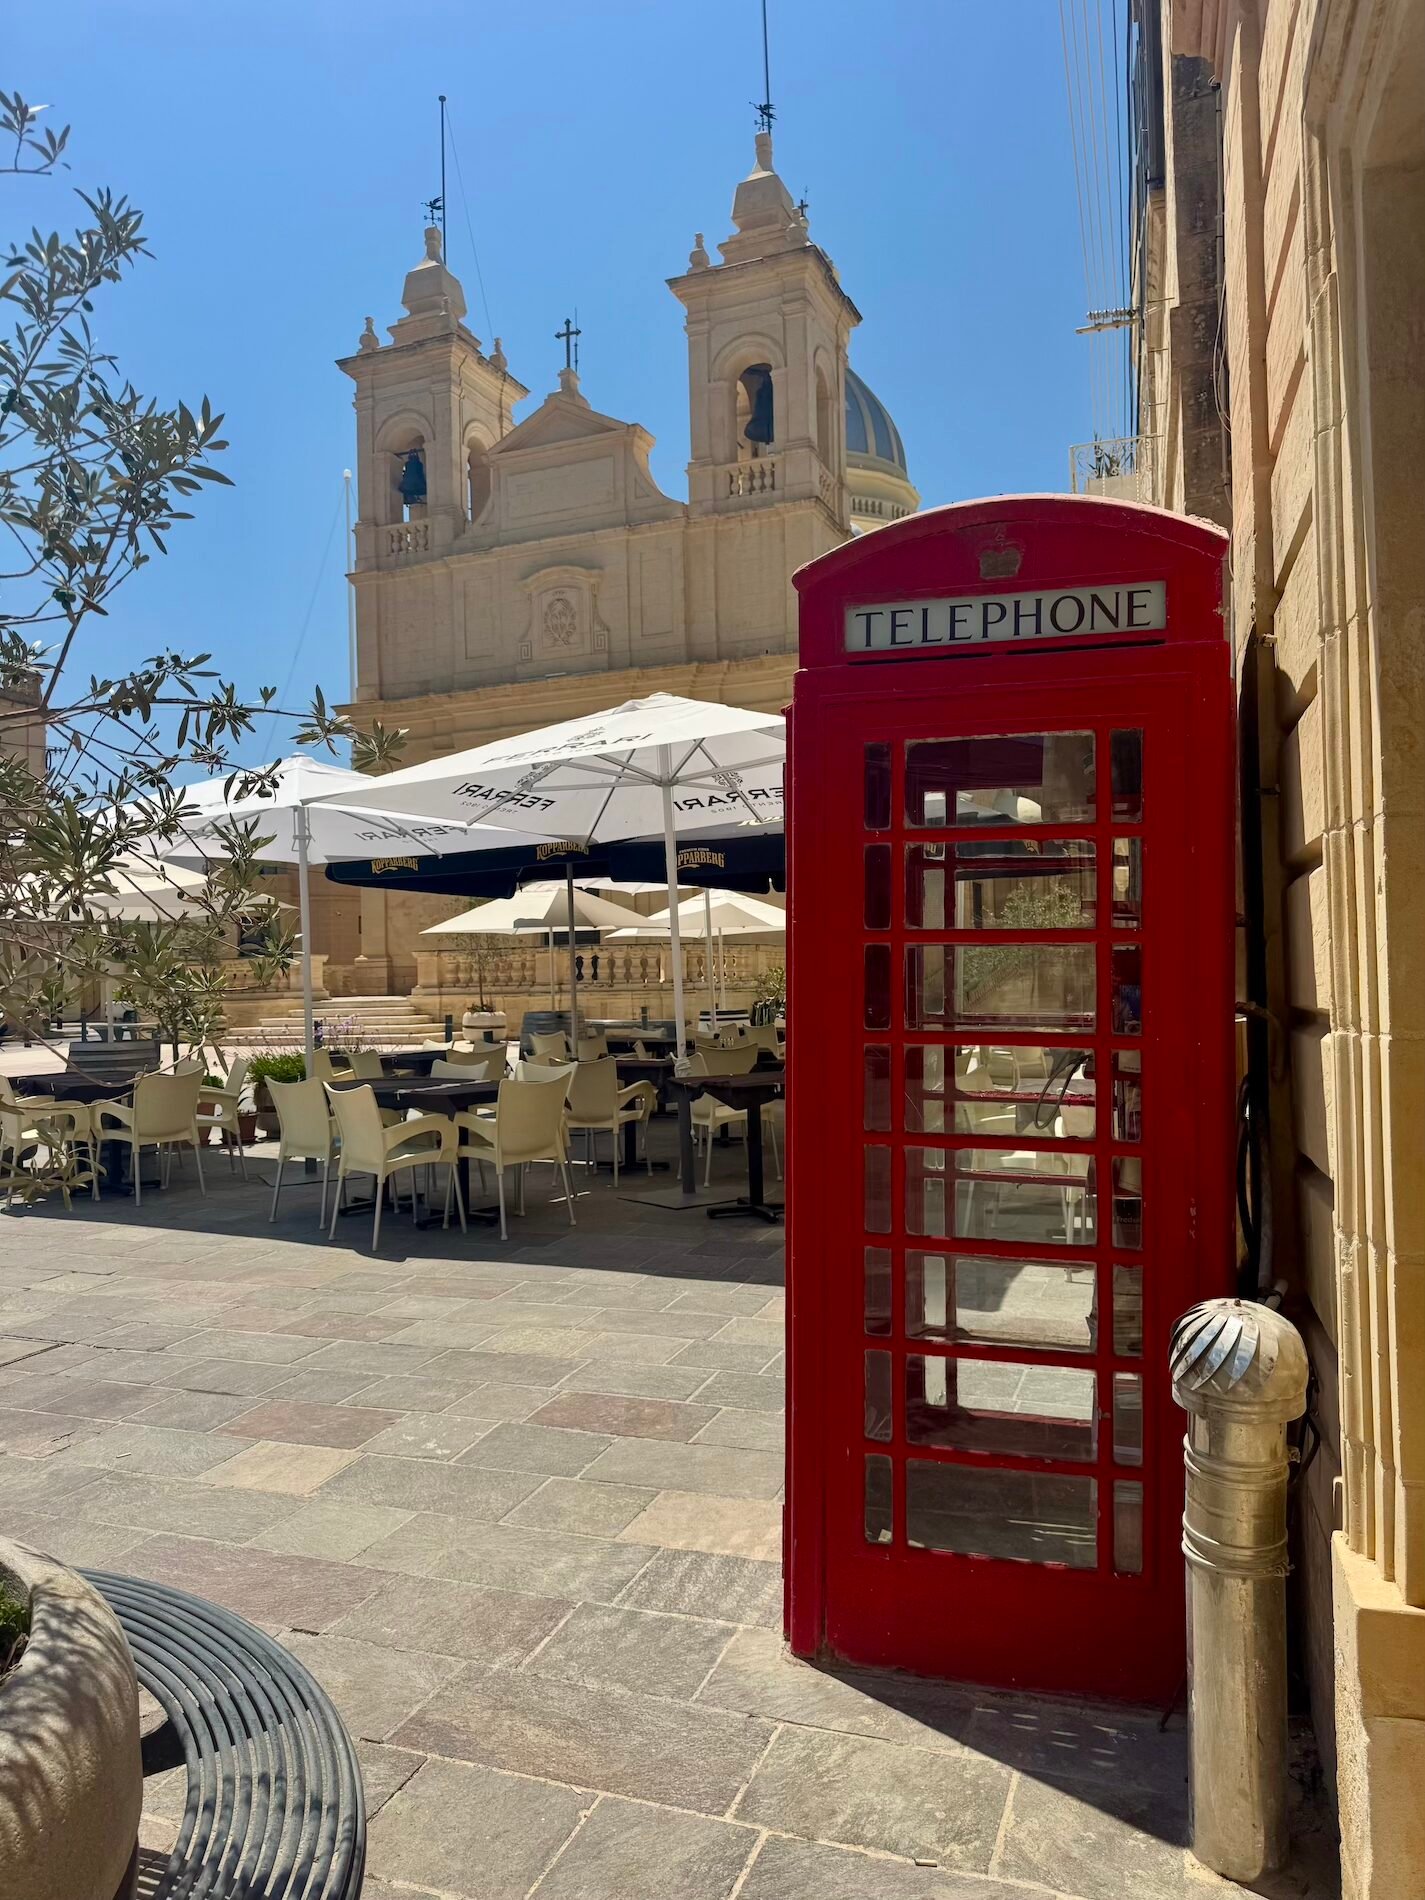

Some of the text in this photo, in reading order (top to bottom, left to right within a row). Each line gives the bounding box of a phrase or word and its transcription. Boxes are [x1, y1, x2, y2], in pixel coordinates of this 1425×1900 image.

[855, 589, 1153, 648] TELEPHONE
[371, 857, 419, 874] KOPPARBERG
[676, 850, 725, 869] PPARBERG
